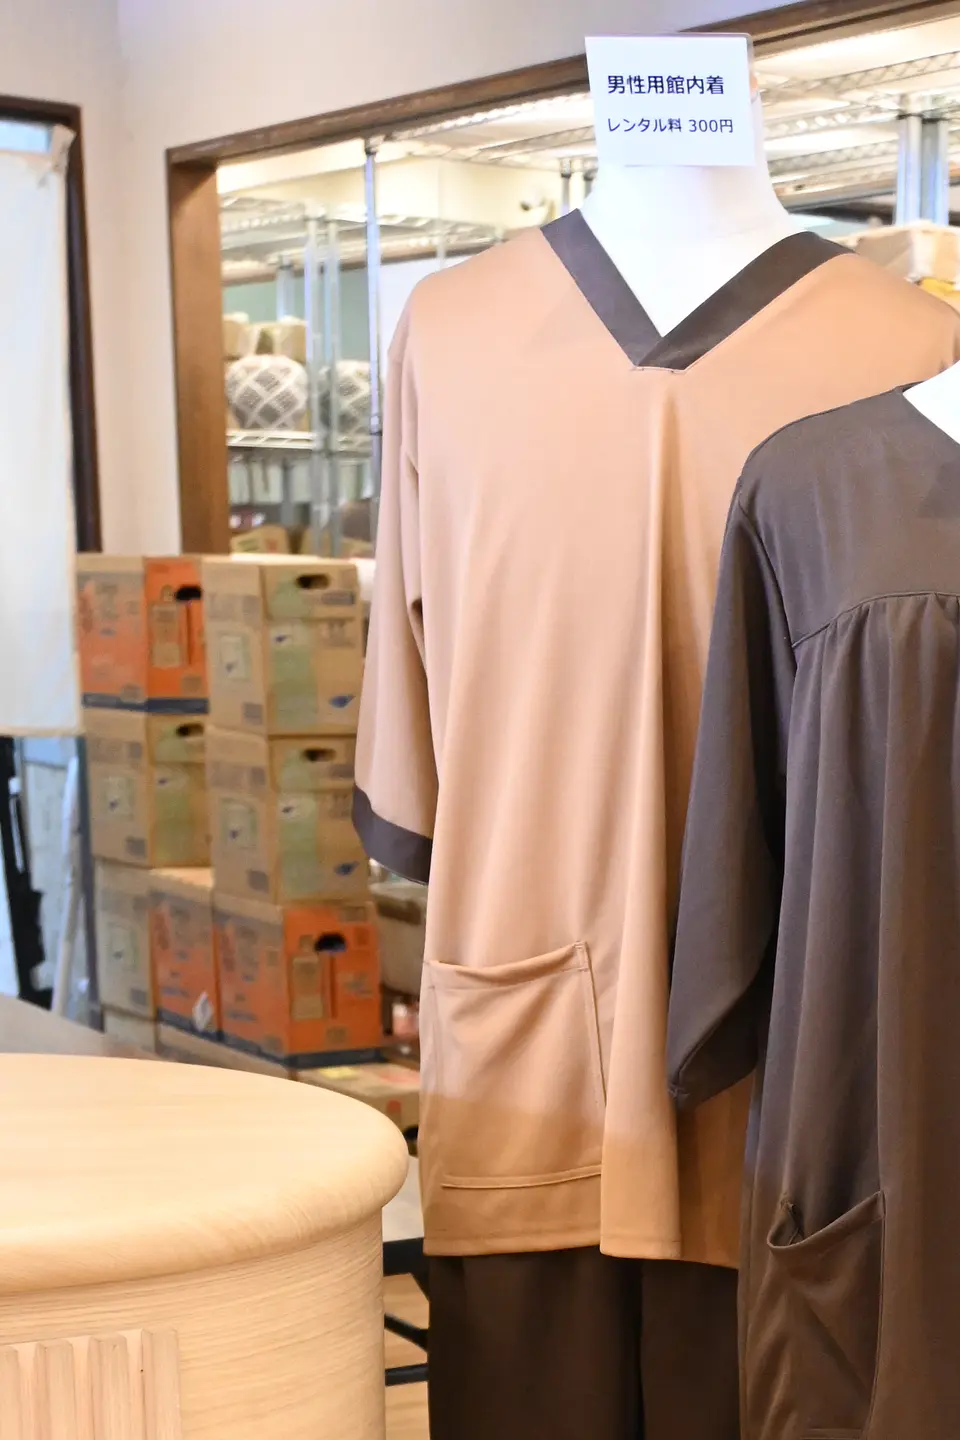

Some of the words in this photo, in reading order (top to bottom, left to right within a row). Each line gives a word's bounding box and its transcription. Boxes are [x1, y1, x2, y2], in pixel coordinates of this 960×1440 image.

[608, 75, 725, 95] 男性用館内着
[607, 118, 682, 133] レンタル料
[688, 118, 734, 133] 300円
